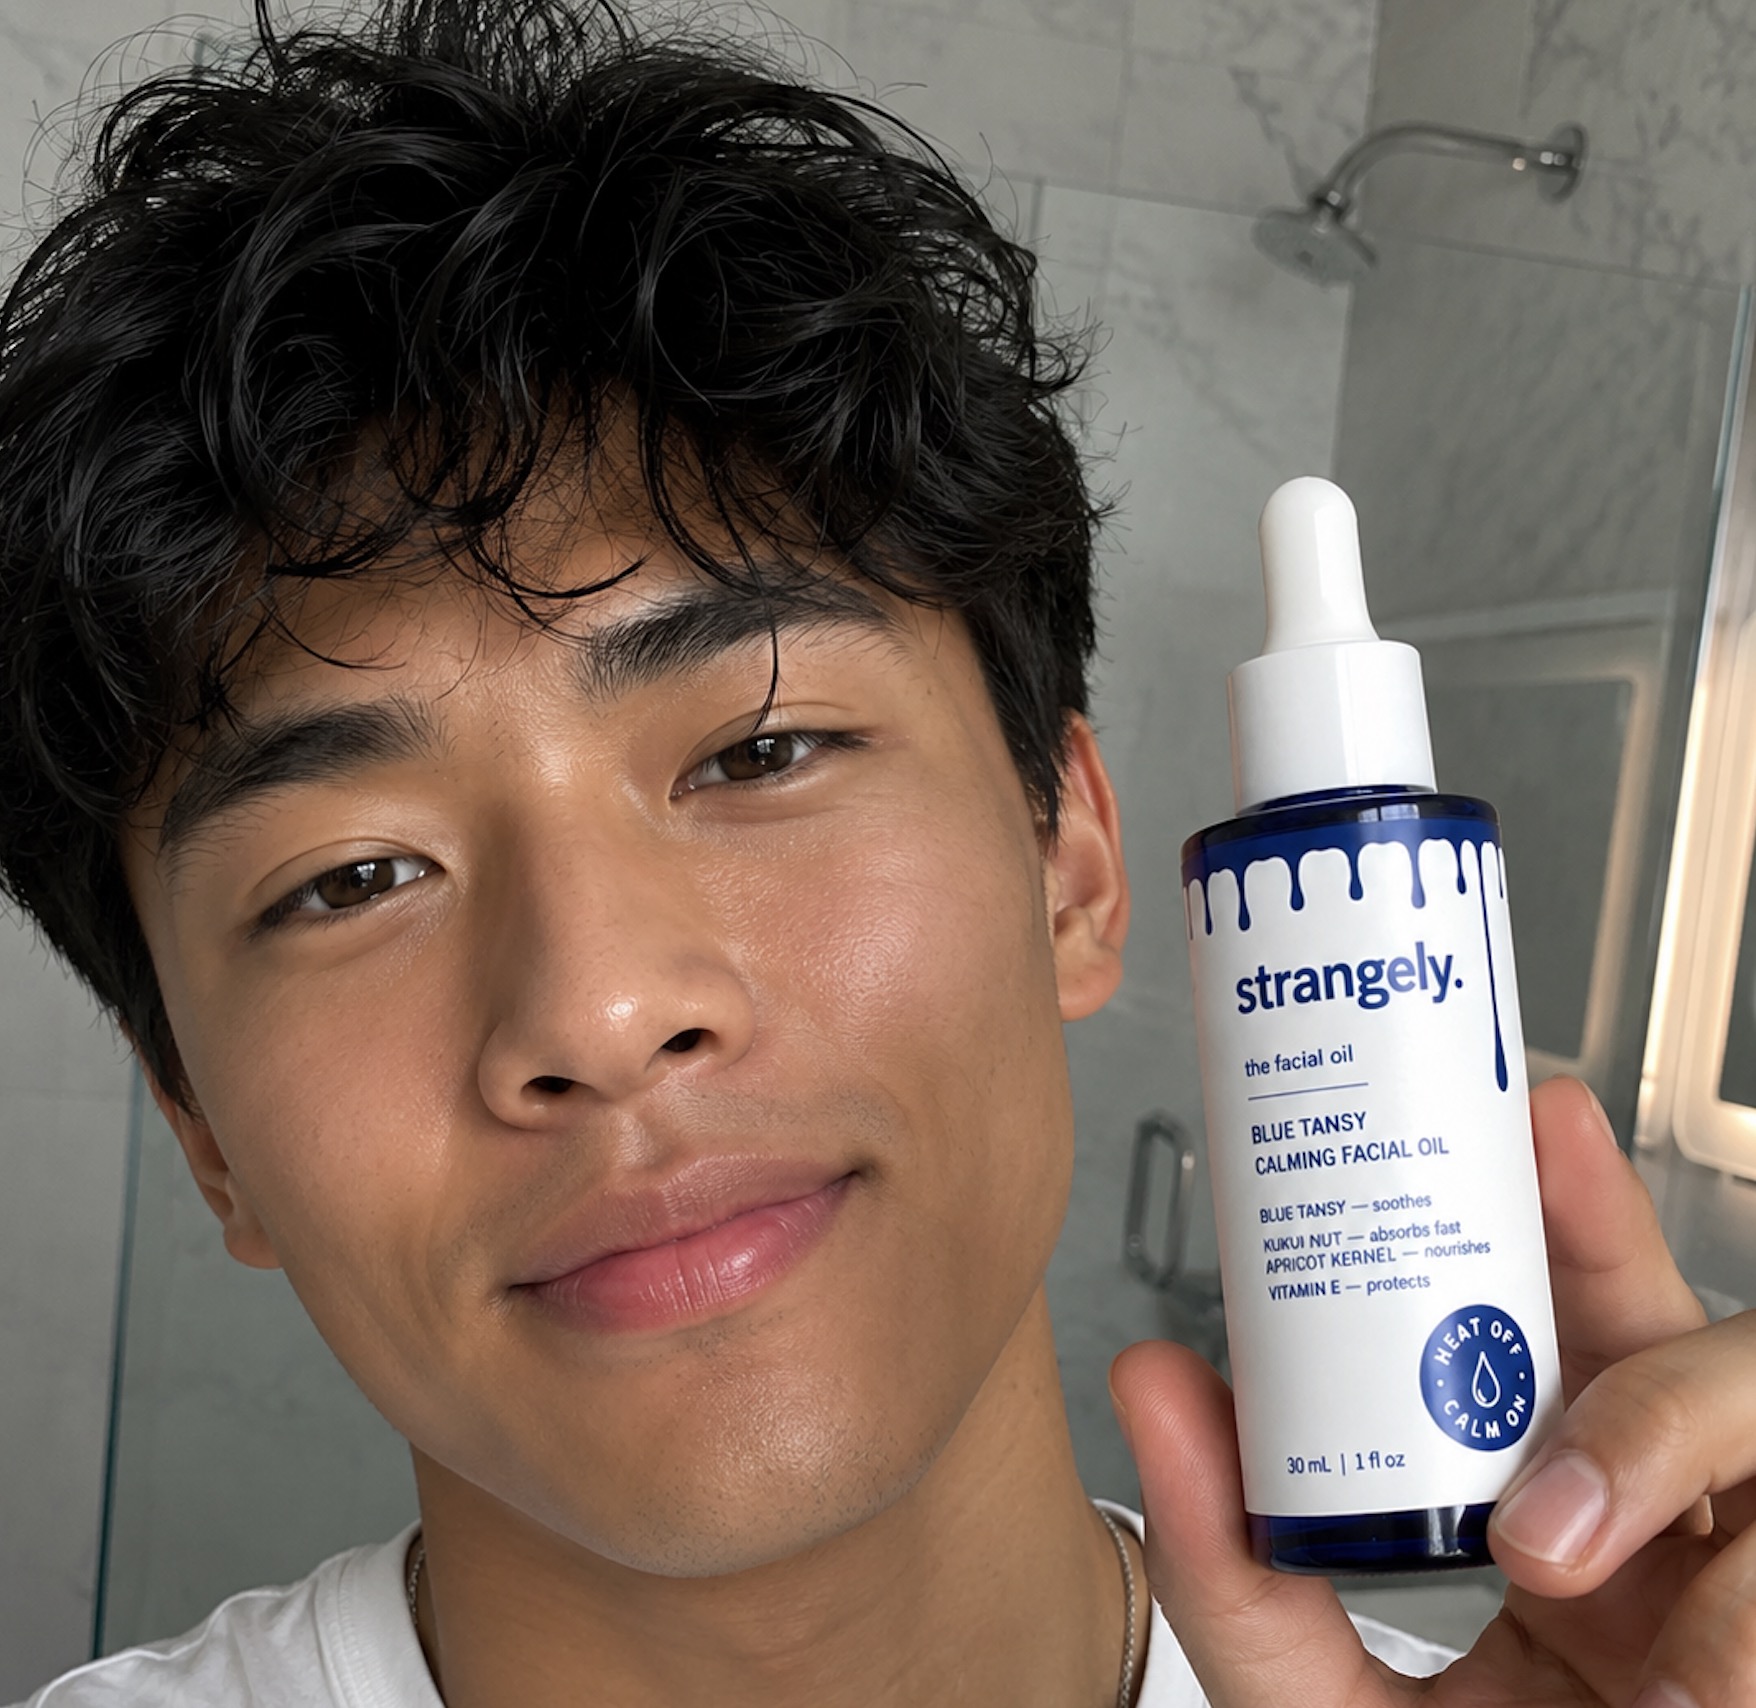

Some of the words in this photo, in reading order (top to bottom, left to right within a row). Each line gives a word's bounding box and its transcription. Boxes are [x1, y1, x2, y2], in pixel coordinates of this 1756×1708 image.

[1236, 941, 1463, 1014] strangely.
[1245, 1059, 1270, 1077] the
[1274, 1049, 1323, 1072] facial
[1331, 1045, 1353, 1064] oil
[1252, 1120, 1295, 1144] BLUE
[1300, 1111, 1366, 1137] TANSY
[1256, 1148, 1336, 1175] CALMING
[1342, 1139, 1412, 1164] FACIAL
[1418, 1137, 1449, 1156] OIL
[1260, 1207, 1293, 1223] BLUE
[1296, 1200, 1345, 1219] TANSY
[1372, 1194, 1431, 1212] soothes
[1263, 1236, 1304, 1252] KUKUI
[1309, 1232, 1342, 1248] NUT
[1370, 1223, 1430, 1242] absorbs
[1434, 1220, 1461, 1236] fast
[1266, 1254, 1326, 1274] APRICOT
[1331, 1248, 1396, 1267] KERNEL
[1425, 1240, 1490, 1258] nourishes
[1268, 1281, 1326, 1300] VITAMIN
[1331, 1280, 1341, 1294] E
[1367, 1273, 1430, 1295] protects
[1434, 1317, 1480, 1365] HEAT
[1490, 1320, 1522, 1356] OFF
[1444, 1400, 1500, 1438] CALM
[1506, 1394, 1526, 1426] ON
[1287, 1457, 1304, 1474] 30
[1308, 1456, 1331, 1473] mL
[1355, 1453, 1363, 1470] 1
[1368, 1451, 1380, 1468] fl
[1385, 1453, 1405, 1467] oz
